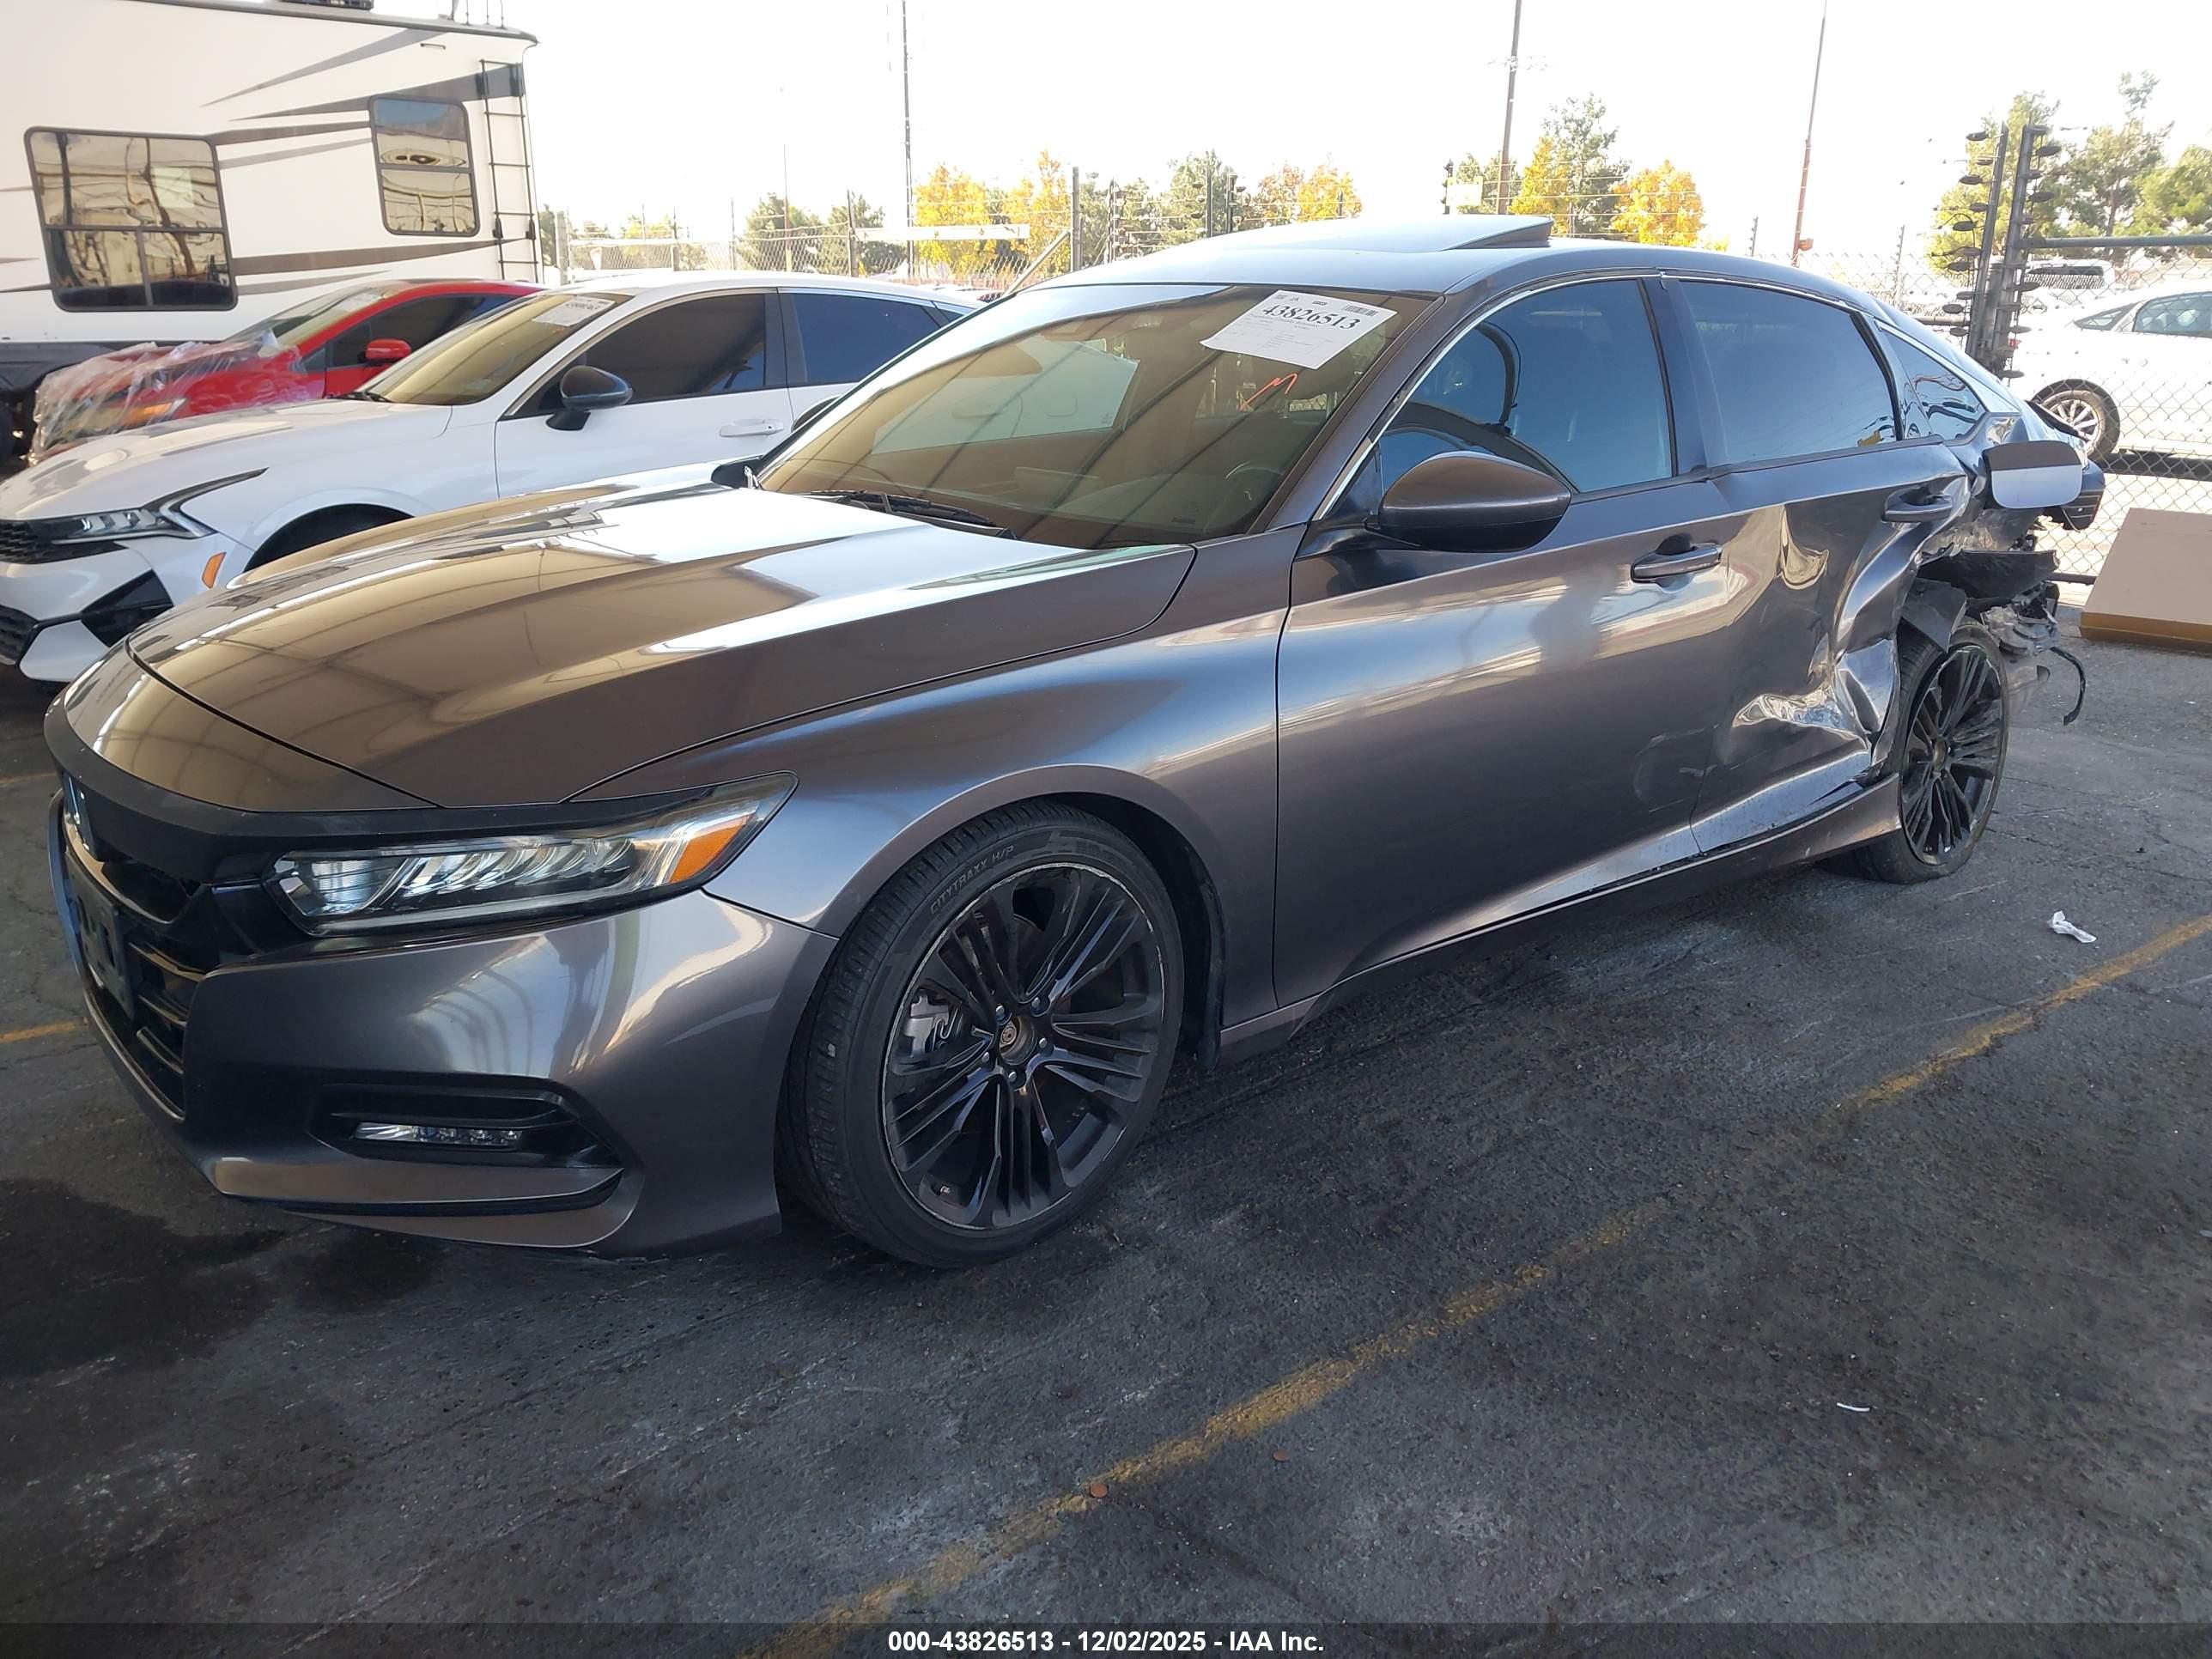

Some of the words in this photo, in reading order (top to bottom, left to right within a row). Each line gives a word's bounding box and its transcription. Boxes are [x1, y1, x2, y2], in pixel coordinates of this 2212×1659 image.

[1262, 304, 1361, 330] 43826513
[930, 859, 988, 915] CITYTRAXX
[991, 844, 1015, 864] H/P
